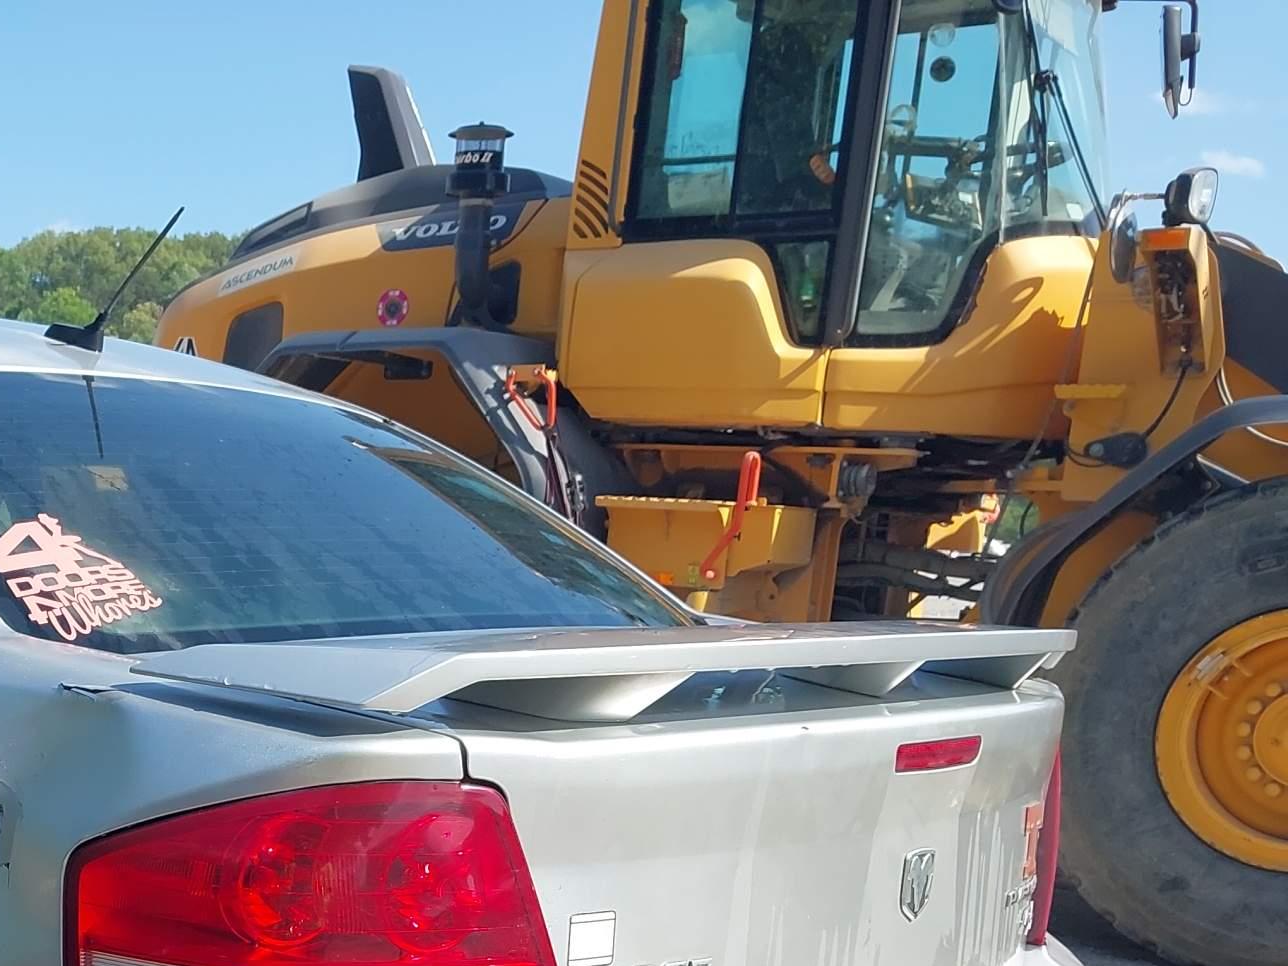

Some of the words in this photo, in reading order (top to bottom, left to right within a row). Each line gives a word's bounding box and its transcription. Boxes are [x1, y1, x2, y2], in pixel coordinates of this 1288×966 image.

[392, 215, 507, 241] VOLO
[221, 256, 294, 291] ASCENDUM
[6, 564, 136, 598] DOORS
[55, 579, 145, 607] MORE
